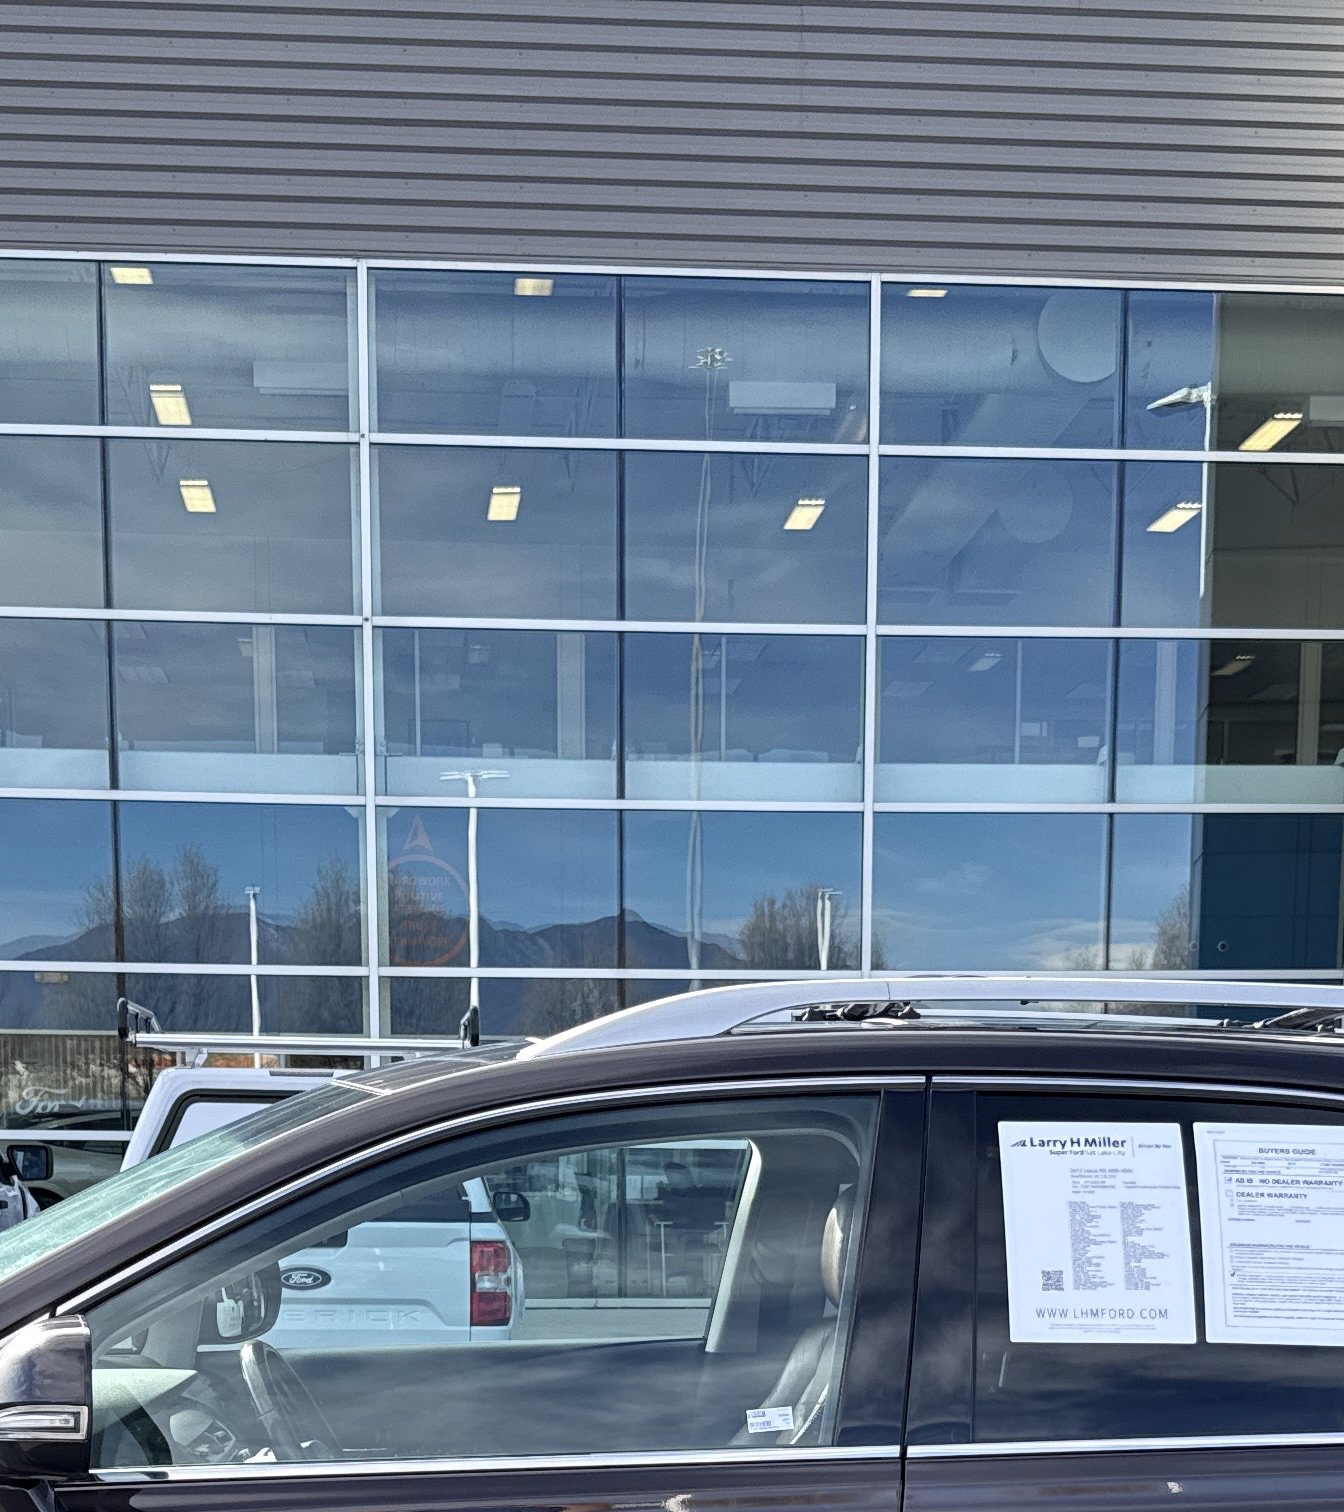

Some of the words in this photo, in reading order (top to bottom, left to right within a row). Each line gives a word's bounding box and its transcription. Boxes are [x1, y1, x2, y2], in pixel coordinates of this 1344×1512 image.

[1030, 1137, 1066, 1149] Larry
[1070, 1137, 1081, 1147] H
[1084, 1136, 1127, 1148] Miller
[1258, 1147, 1290, 1155] BUYERS
[1271, 1178, 1301, 1186] DEALER
[1301, 1179, 1343, 1187] WARRANTY
[288, 1273, 315, 1284] Ford
[281, 1308, 420, 1323] ERICK
